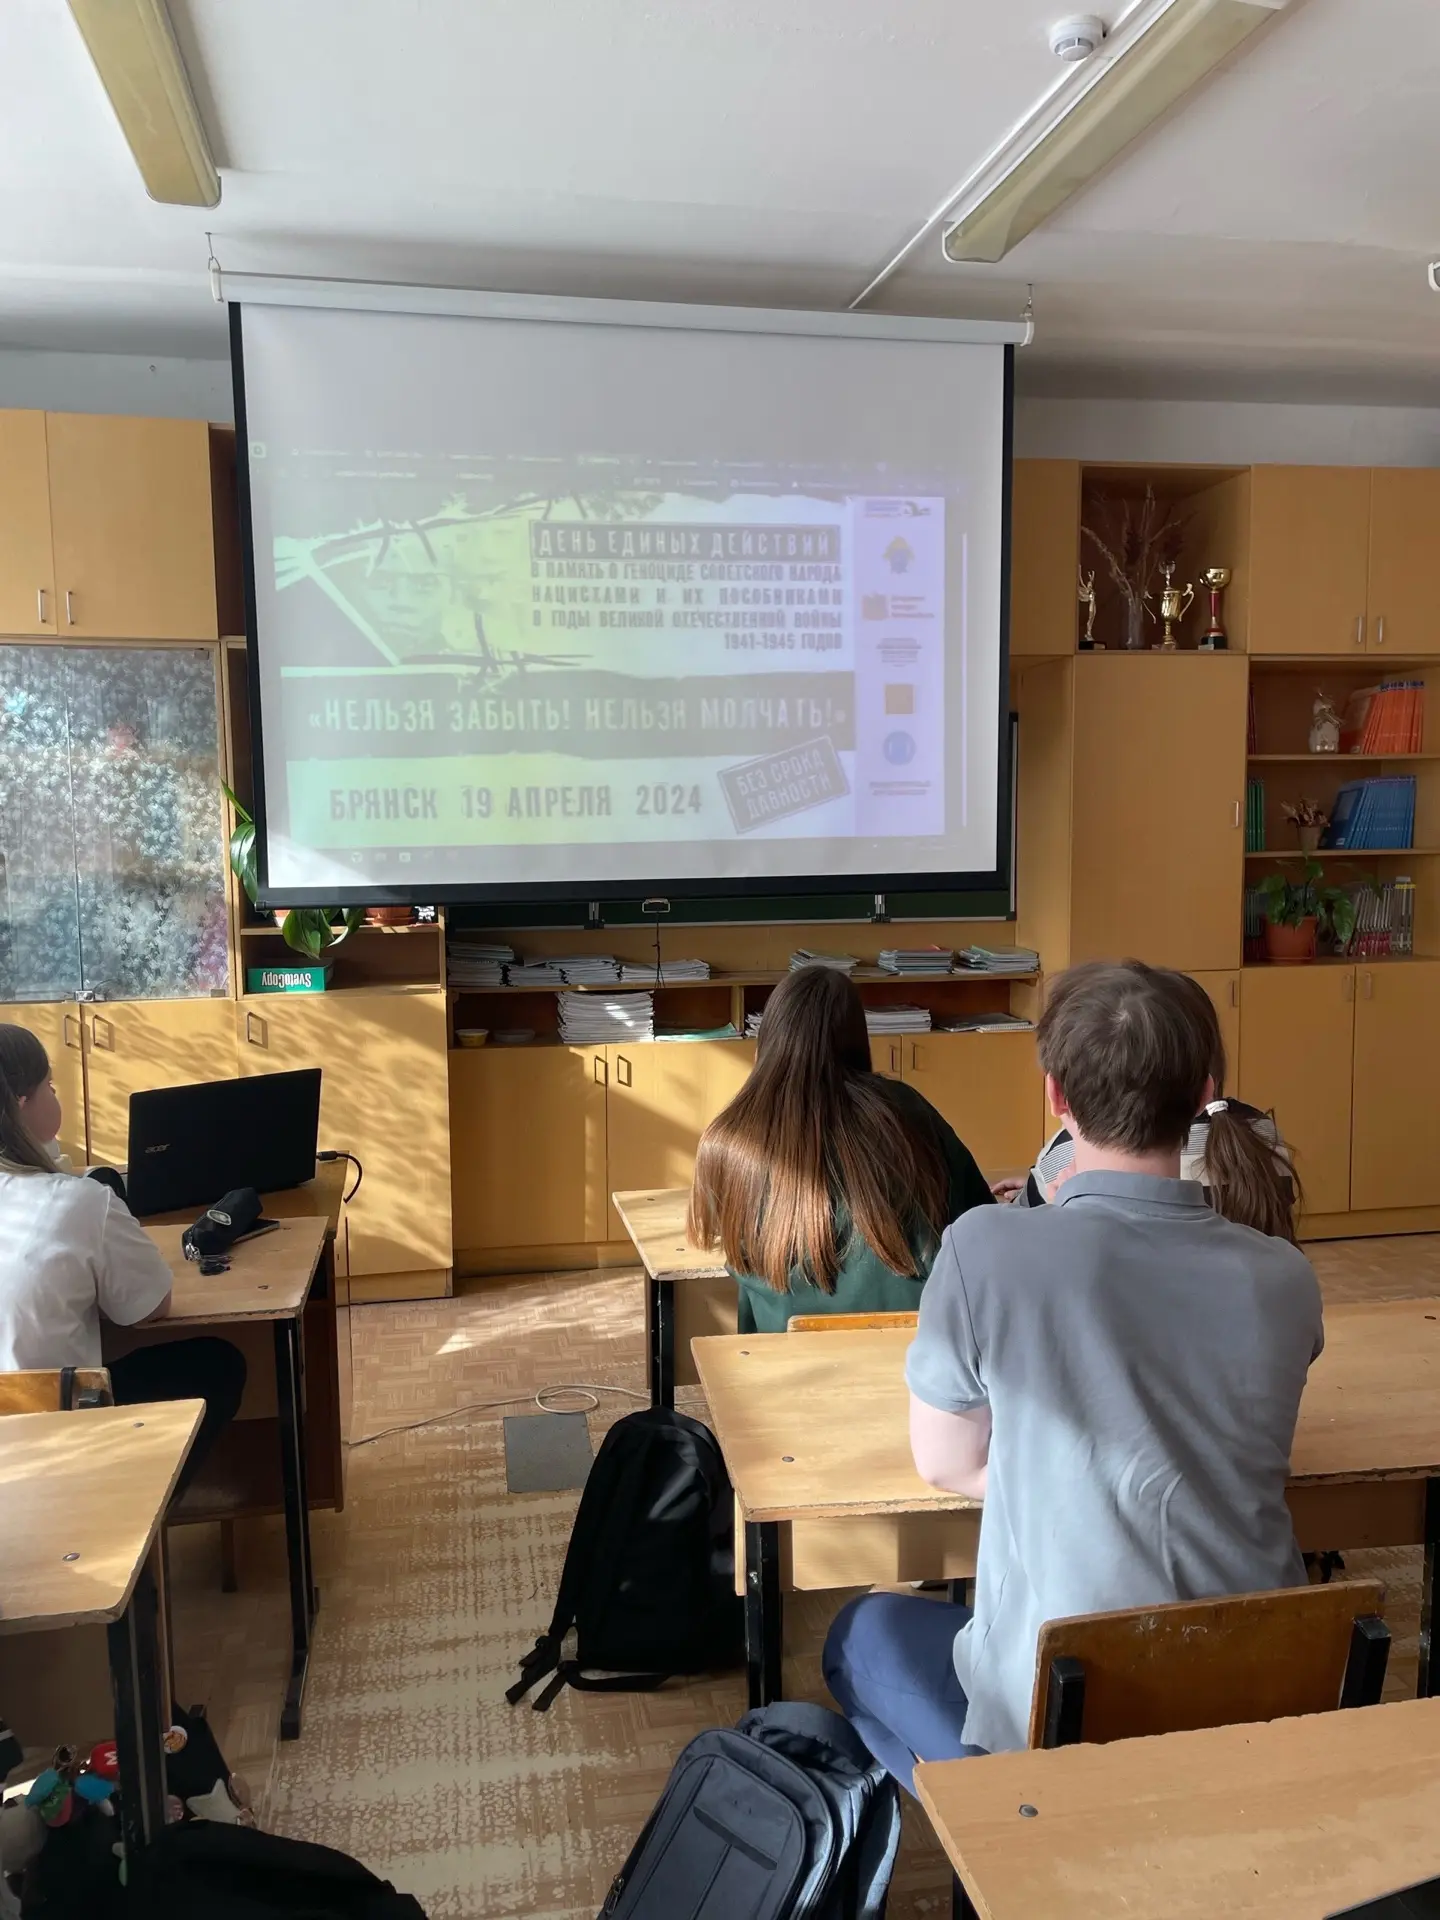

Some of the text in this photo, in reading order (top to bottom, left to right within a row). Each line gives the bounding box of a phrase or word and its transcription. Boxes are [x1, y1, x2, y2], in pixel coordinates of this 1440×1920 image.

[539, 529, 829, 559] ДЕНЬ ЕДИНЫХ ДЕЙСТВИЙ
[546, 561, 604, 579] ПАМЯТЬ
[609, 561, 618, 579] О
[623, 562, 695, 582] ГЕНОЦИДЕ
[700, 563, 784, 581] СОВЕТСКОГО
[789, 564, 842, 584] НАРОДА
[532, 585, 843, 606] НАЦИСТАМИ И ИХ ПОСОБНИКАМИ
[551, 609, 591, 630] ГОДЫ
[599, 608, 665, 628] ВЕЛИКОЙ
[672, 608, 786, 629] ОТЕЧЕСТВЕННОЙ
[794, 608, 842, 629] ВОЙНЫ
[724, 632, 843, 652] 1941-1945 ГОДОВ
[308, 698, 436, 732] «НЕЛЬЗЯ
[449, 698, 571, 732] ЗАБЫТЬ!
[584, 697, 686, 731] НЕЛЬЗЯ
[736, 748, 825, 797] БЕЗ СРОКА
[329, 784, 702, 821] БРЯНСК 19 АПРЕЛЯ 2024
[745, 771, 832, 820] ДАВНОСТИ
[261, 971, 312, 988] SvetoCopy
